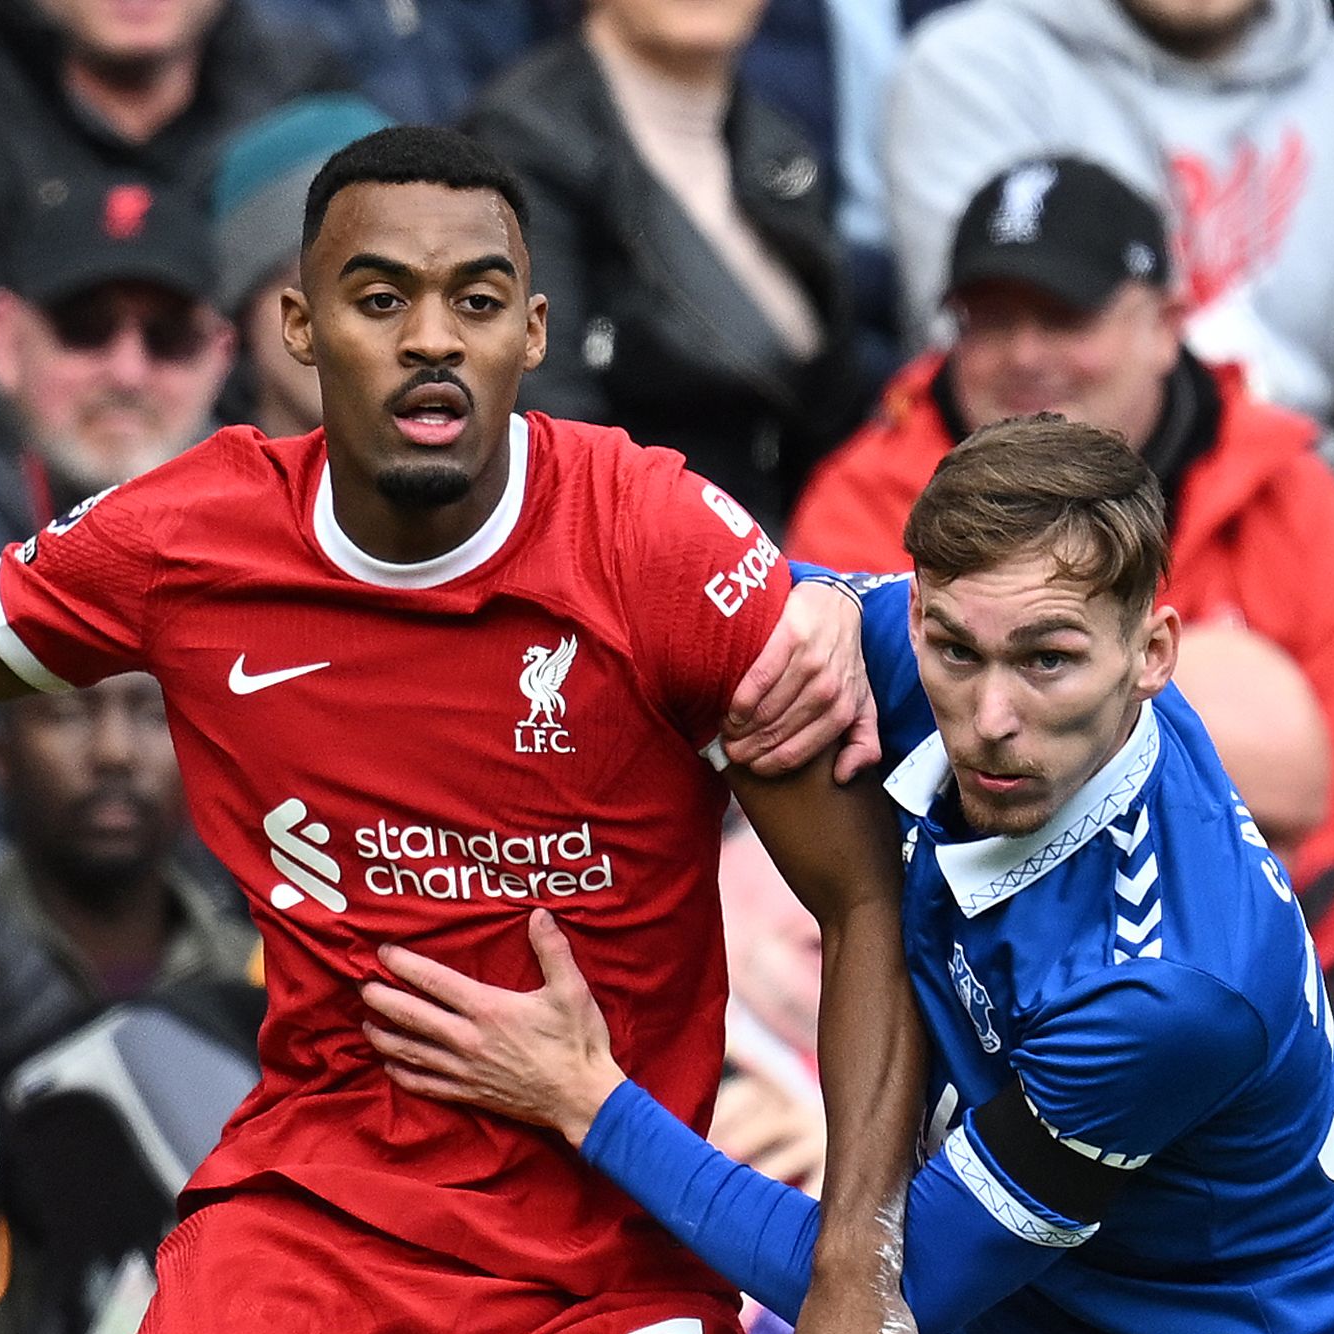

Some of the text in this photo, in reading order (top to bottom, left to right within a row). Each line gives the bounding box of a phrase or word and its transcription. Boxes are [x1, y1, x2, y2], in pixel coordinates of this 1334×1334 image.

[514, 728, 576, 753] L.F.C.
[355, 818, 592, 865] standard
[365, 853, 613, 899] chartered
